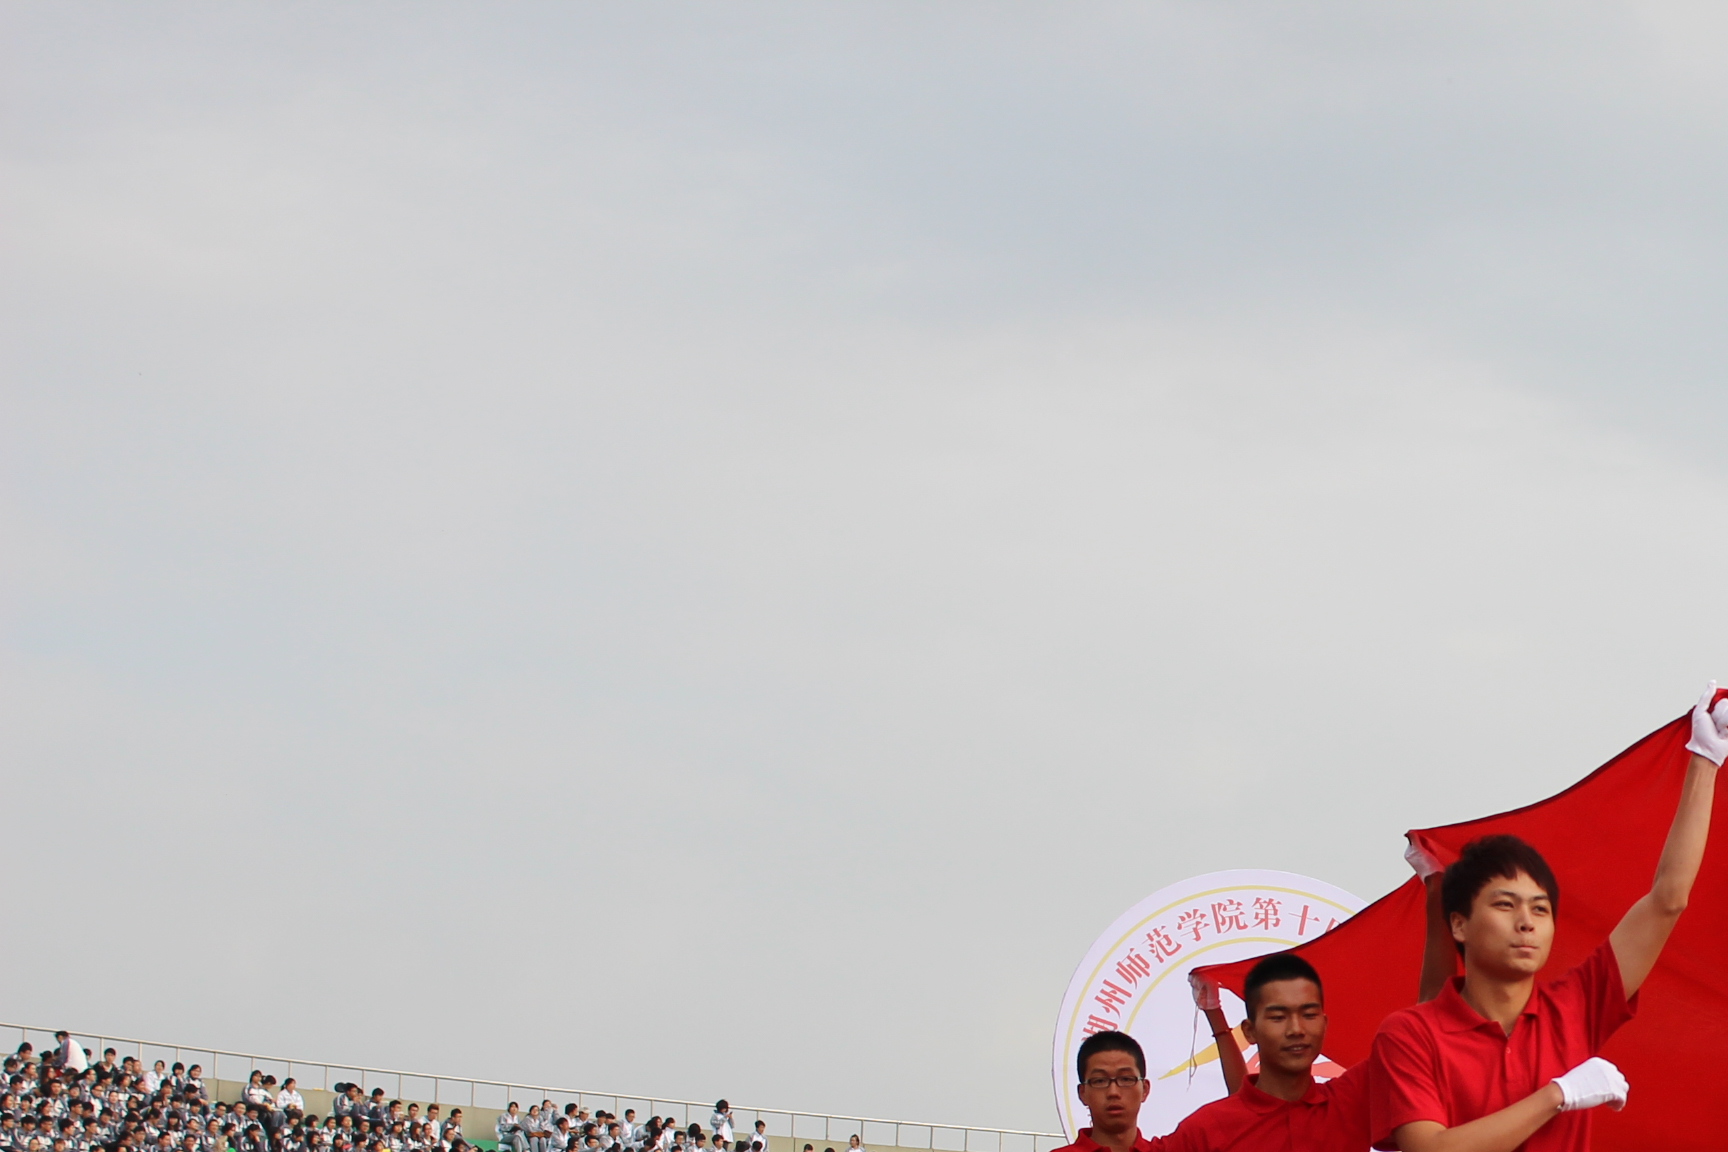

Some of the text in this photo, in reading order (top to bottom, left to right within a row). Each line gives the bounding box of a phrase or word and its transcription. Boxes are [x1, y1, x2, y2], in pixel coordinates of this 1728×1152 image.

[1081, 897, 1340, 1041] 州师范学院第十
